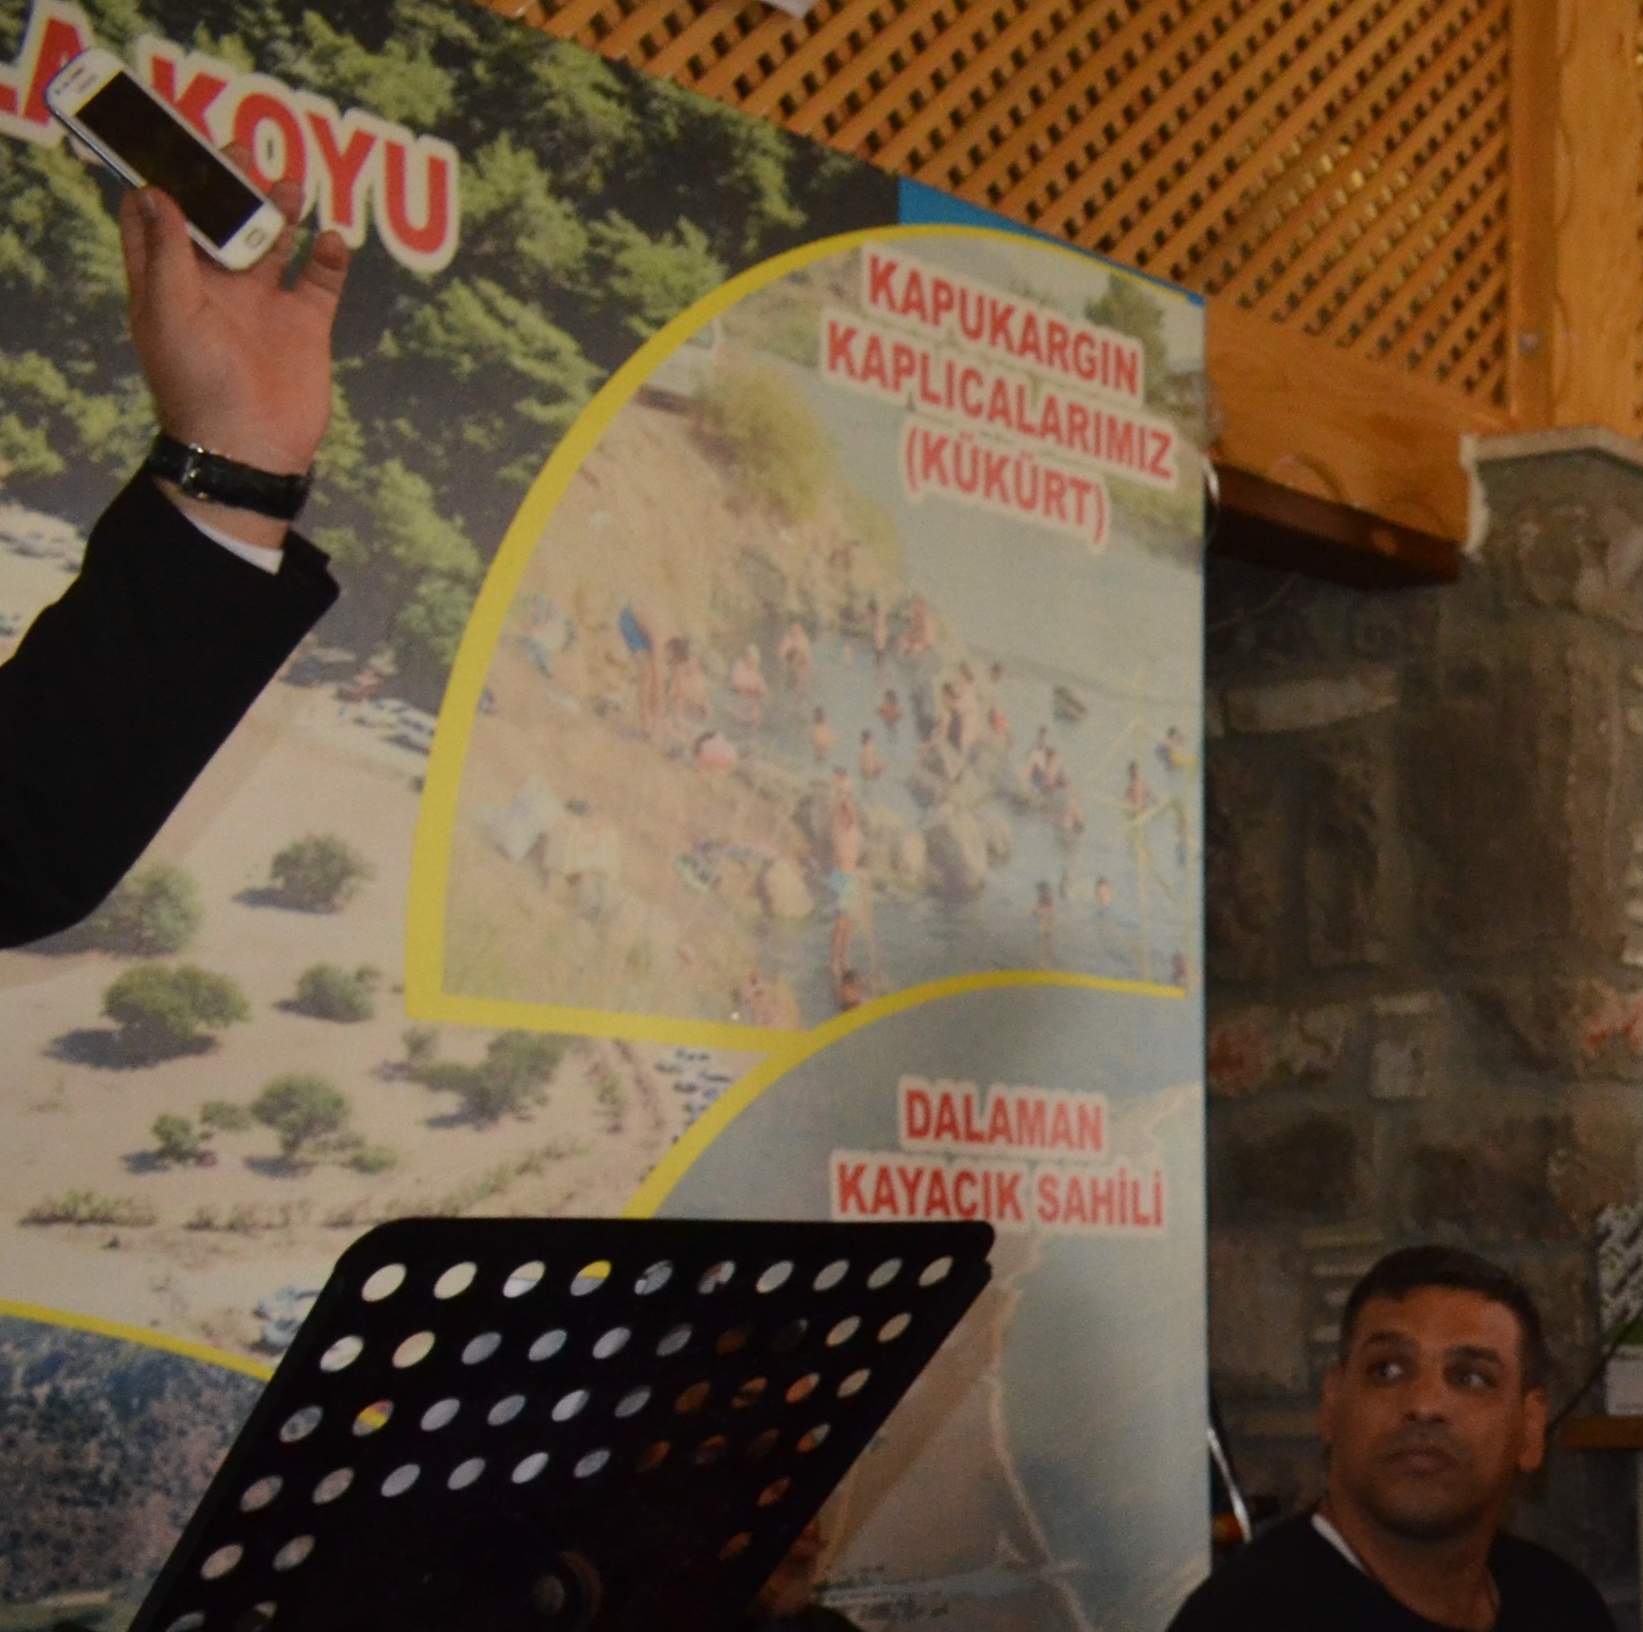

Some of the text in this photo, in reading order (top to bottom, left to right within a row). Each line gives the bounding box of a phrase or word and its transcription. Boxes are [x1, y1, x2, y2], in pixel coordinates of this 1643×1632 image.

[869, 254, 1139, 395] KAPUKARGIN
[827, 321, 1174, 480] KAPLICALARIMIZ
[905, 424, 1106, 543] (KÜKÜRT)
[905, 1089, 1105, 1151] DALAMAN
[836, 1162, 1164, 1228] KAYACIK SAHİLİ
